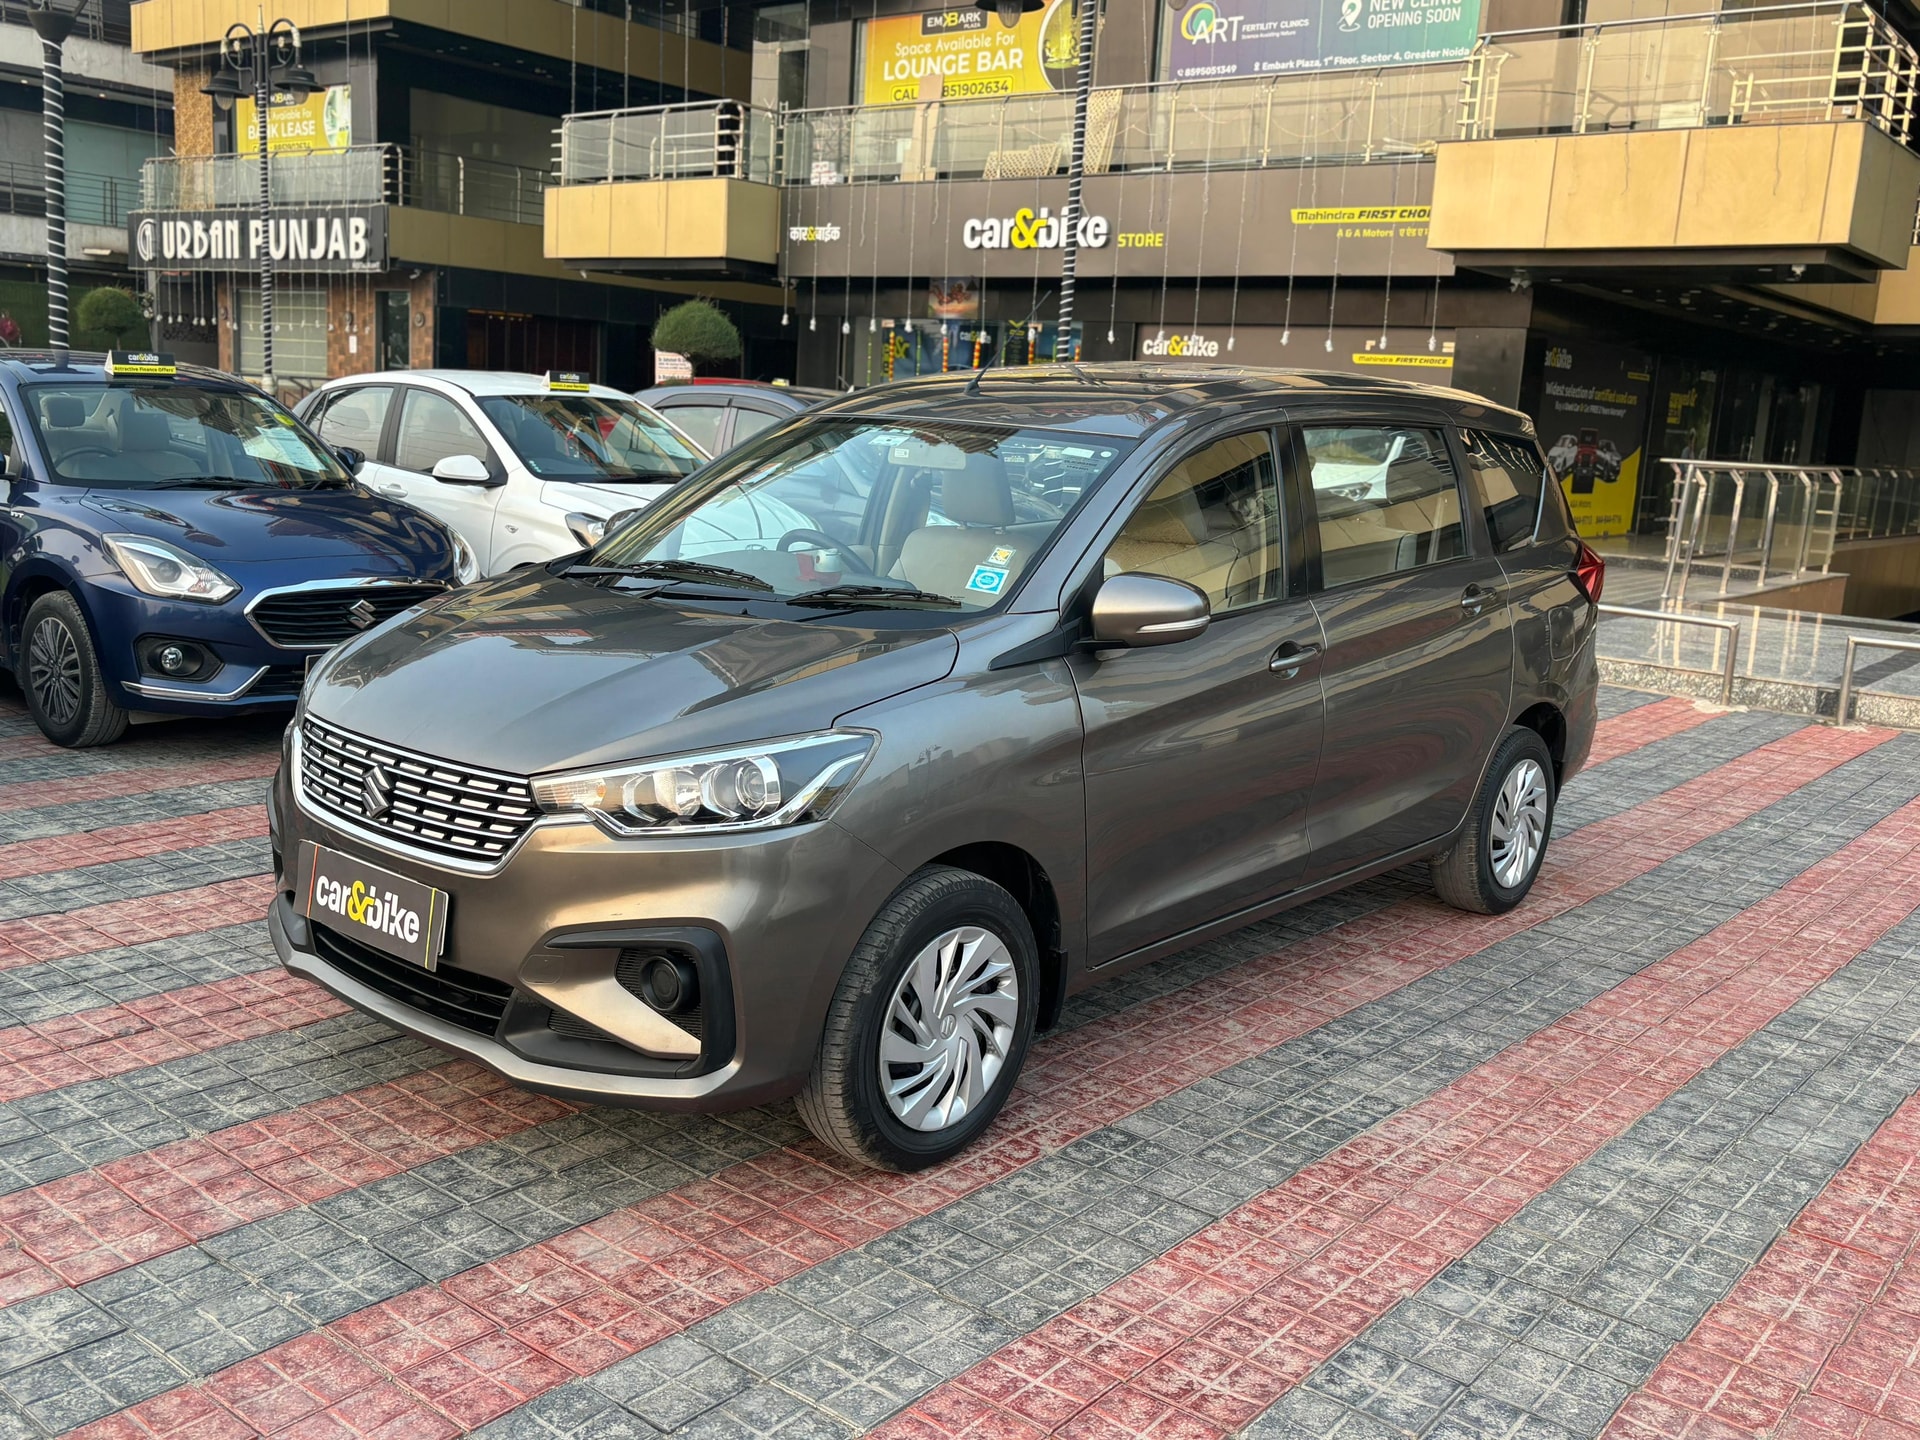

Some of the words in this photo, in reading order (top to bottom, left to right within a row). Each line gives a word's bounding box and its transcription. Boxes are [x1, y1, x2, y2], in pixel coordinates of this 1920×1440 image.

[1369, 0, 1406, 12] NEW
[1367, 11, 1422, 29] OPENING
[1426, 7, 1461, 24] SOON
[1192, 16, 1244, 45] ART
[1242, 21, 1278, 32] FERTILITY
[1280, 19, 1309, 28] CLINICS
[895, 41, 932, 58] Space
[935, 34, 992, 52] Available
[995, 31, 1016, 46] For
[883, 52, 970, 81] LOUNGE
[977, 48, 1023, 73] BAR
[1262, 59, 1295, 71] Embark
[1296, 57, 1322, 69] Plaza,
[1360, 53, 1393, 64] Sector
[1404, 49, 1441, 61] Greater
[1442, 47, 1470, 57] Noida
[1185, 65, 1237, 77] 8595051349
[893, 88, 918, 101] CAL
[942, 80, 1009, 97] 851902634
[272, 109, 301, 120] Available
[302, 108, 312, 118] For
[281, 120, 316, 137] LEASE
[1296, 211, 1355, 221] Mahindra
[1357, 209, 1398, 219] FIRST
[1399, 208, 1431, 219] CHOI
[162, 219, 240, 260] URBAN
[249, 217, 367, 260] PUNJAB
[963, 207, 1109, 249] car&bike
[1117, 232, 1164, 247] STORE
[1336, 228, 1343, 238] A
[1345, 228, 1352, 238] &
[1354, 228, 1361, 238] A
[1362, 228, 1394, 238] Motors
[1142, 335, 1219, 357] car&bike
[1544, 347, 1572, 369] ar&bike
[1545, 381, 1565, 396] Widest
[1565, 383, 1589, 398] selection
[315, 875, 420, 944] car&bike
